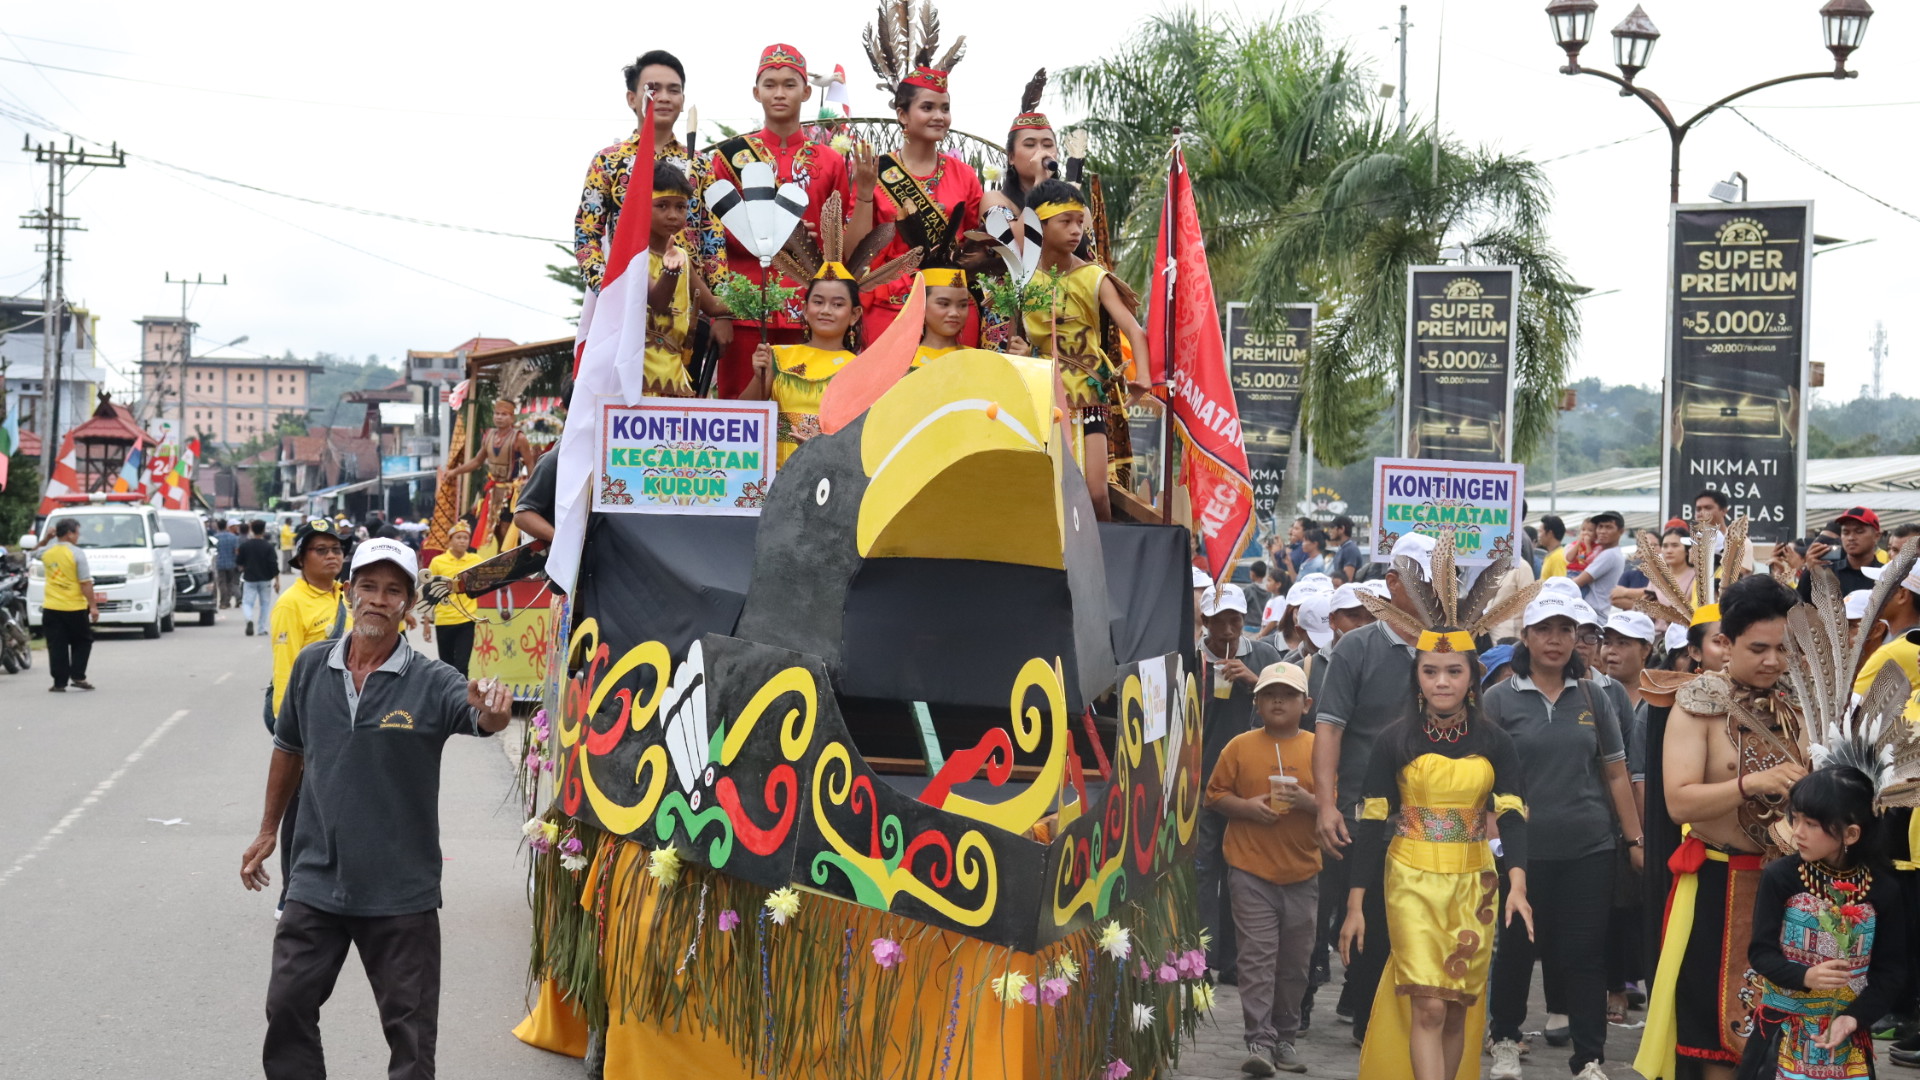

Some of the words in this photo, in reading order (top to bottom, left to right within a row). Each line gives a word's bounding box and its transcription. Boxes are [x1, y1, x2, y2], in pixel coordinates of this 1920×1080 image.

[900, 178, 930, 212] PUTRI
[1725, 228, 1757, 242] 234
[1698, 250, 1783, 270] SUPER
[1681, 271, 1797, 293] PREMIUM
[1430, 303, 1495, 319] SUPER
[1417, 321, 1507, 337] PREMIUM
[1232, 347, 1307, 362] PREMIUM
[613, 416, 759, 443] KONTINGEN
[611, 448, 759, 470] KECAMATAN
[1690, 459, 1778, 476] NIKMATI
[643, 477, 727, 497] KURUN
[1389, 475, 1508, 501] KONTINGEN
[1387, 504, 1508, 525] KECAMATAN
[1682, 505, 1784, 522] BKELAS
